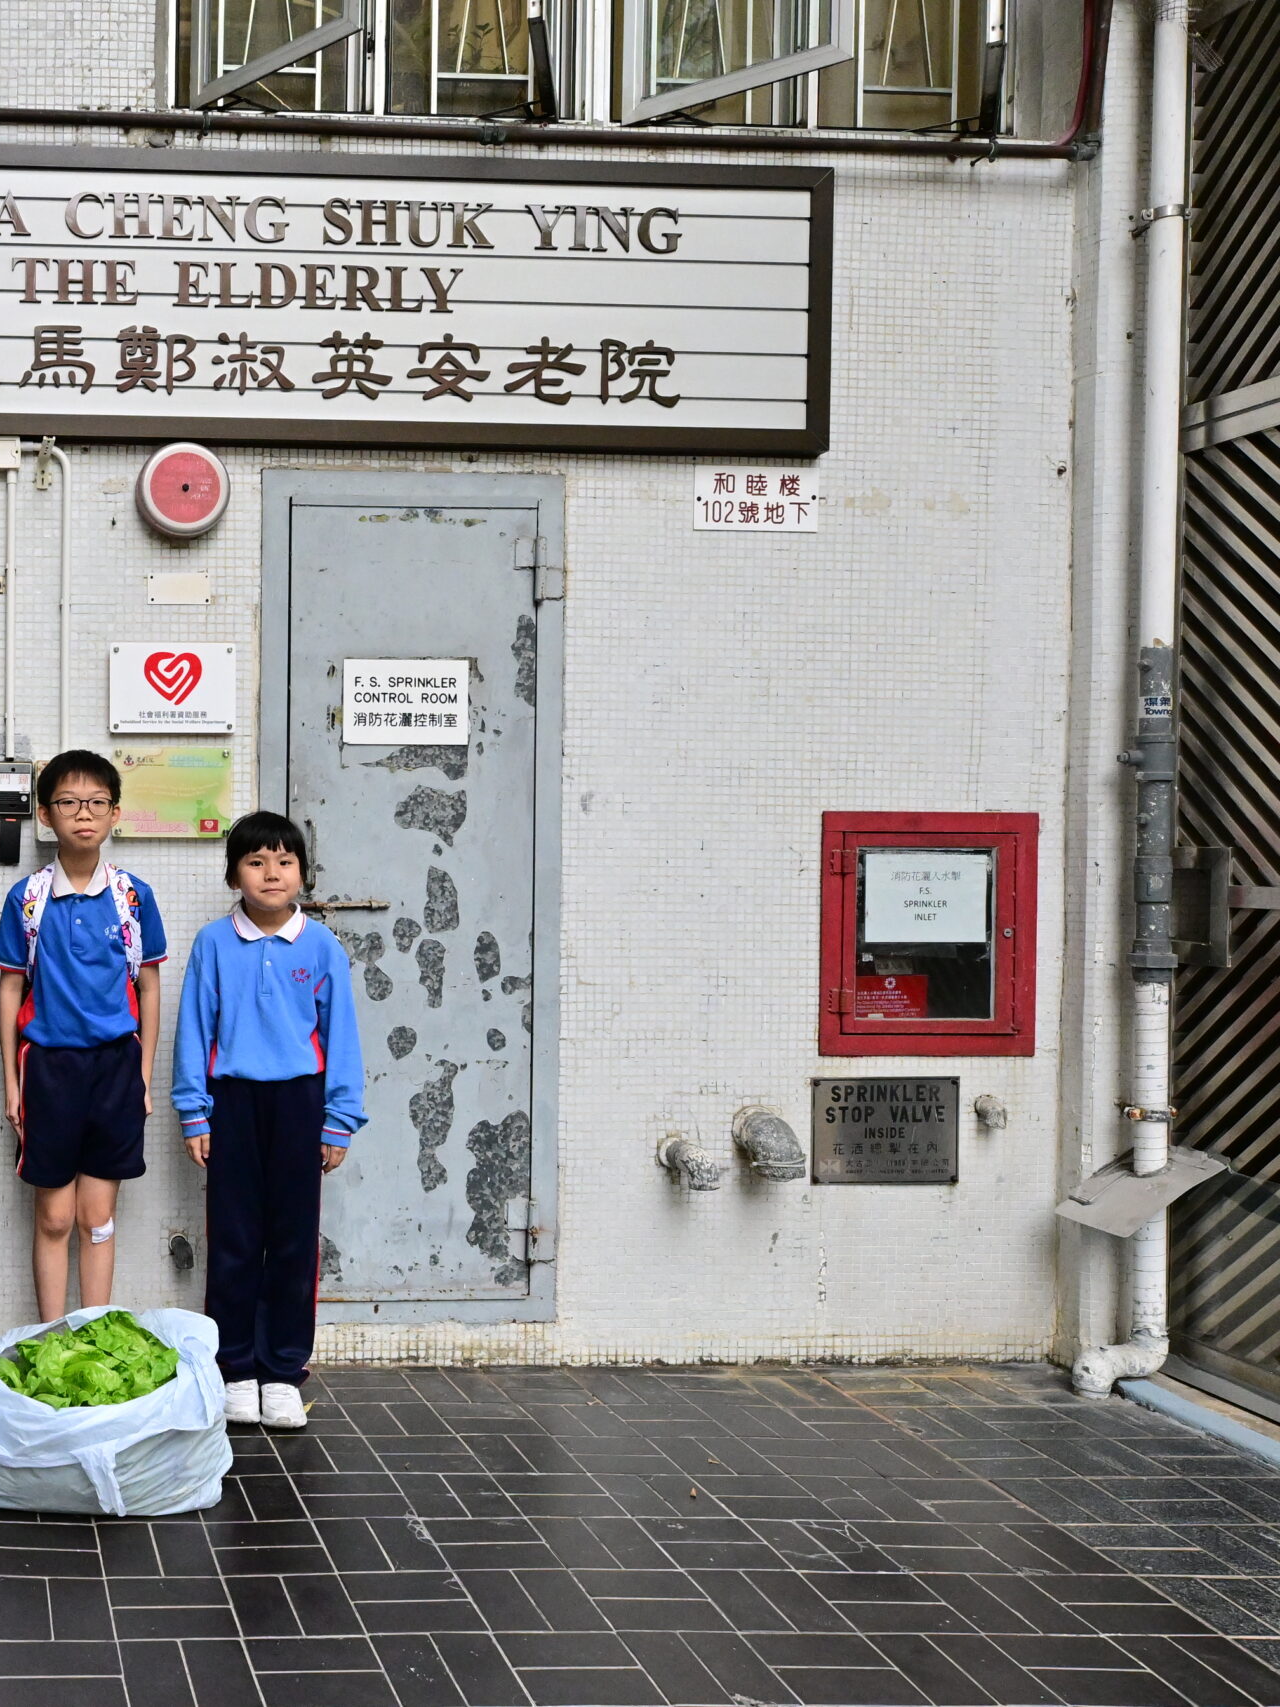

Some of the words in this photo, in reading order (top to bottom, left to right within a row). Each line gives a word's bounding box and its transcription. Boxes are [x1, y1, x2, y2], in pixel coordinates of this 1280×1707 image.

[65, 191, 289, 243] CHENG
[322, 197, 495, 249] SHUK
[525, 203, 682, 254] YING
[11, 257, 138, 305] THE
[173, 260, 464, 313] ELDERLY
[702, 500, 811, 525] 102號地下
[354, 676, 364, 688] F.
[369, 676, 381, 688] S.
[388, 676, 457, 688] SPRINKLER
[353, 692, 414, 703] CONTROL
[421, 693, 458, 704] ROOM
[353, 712, 458, 728] 消防花灑控制室
[919, 886, 933, 895] F.S.
[903, 899, 948, 908] SPRINKLER
[914, 912, 937, 921] INLET
[831, 1084, 941, 1102] SPRINKLER
[825, 1106, 876, 1124] STOP
[889, 1105, 945, 1123] VALVE
[864, 1127, 906, 1139] INSIDE
